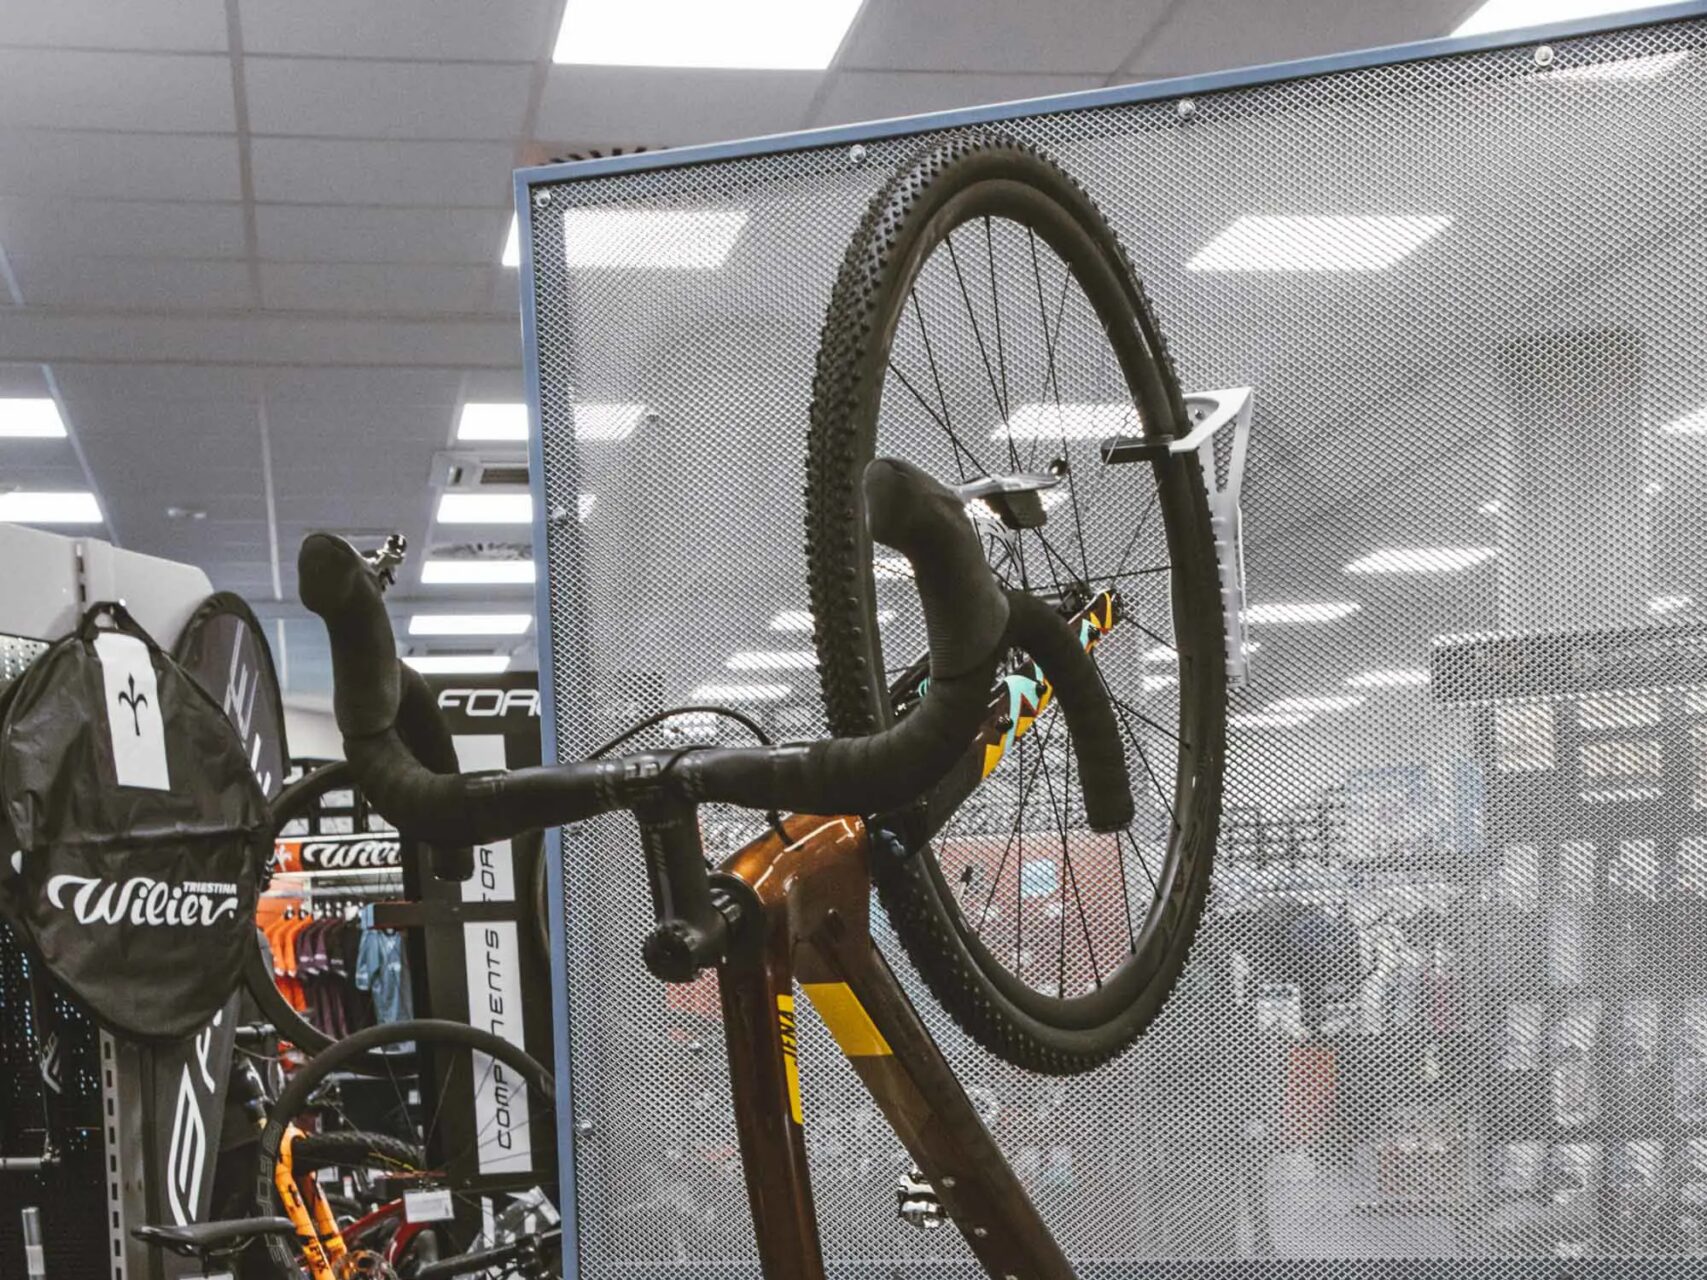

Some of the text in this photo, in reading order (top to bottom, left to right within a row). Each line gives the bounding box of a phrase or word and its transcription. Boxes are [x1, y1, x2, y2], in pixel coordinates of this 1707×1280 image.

[438, 688, 541, 717] FOR
[302, 840, 402, 868] Wili
[47, 874, 239, 927] Wilier
[182, 880, 238, 895] TRIESTINA
[484, 928, 512, 1150] COMPNENTS
